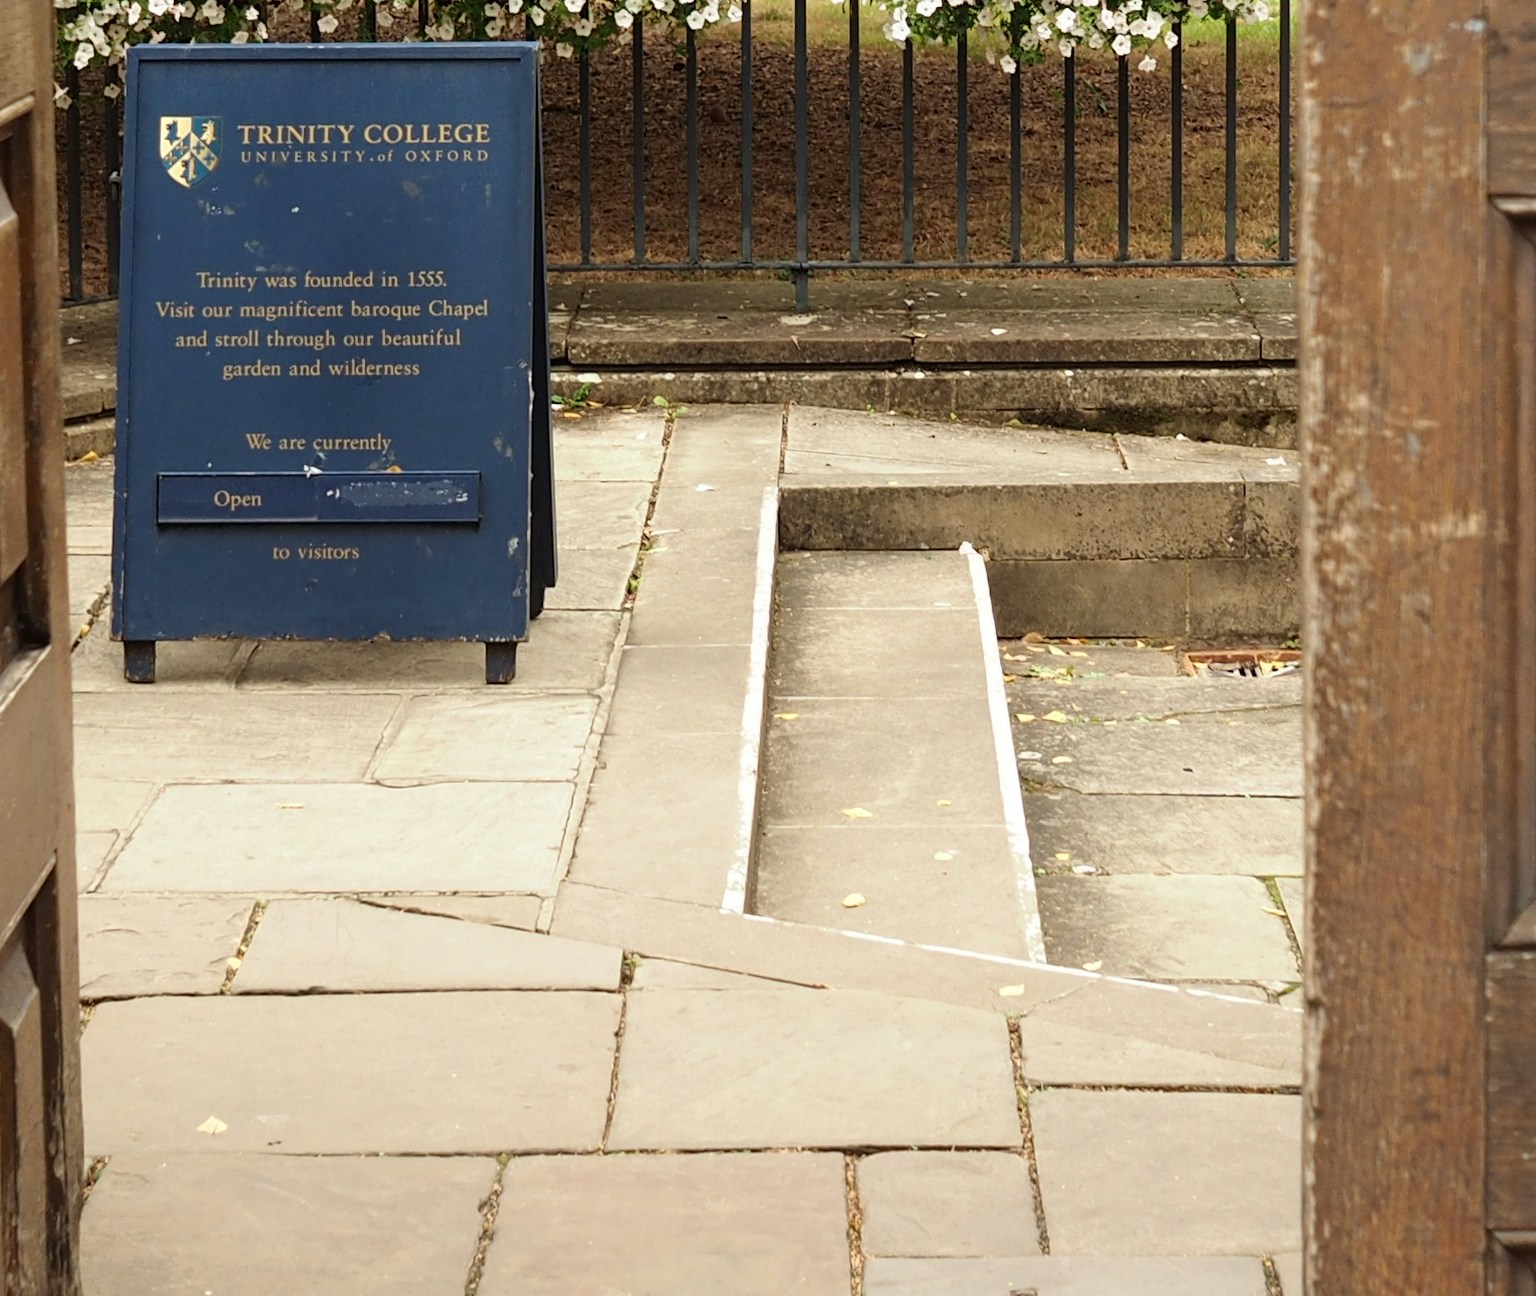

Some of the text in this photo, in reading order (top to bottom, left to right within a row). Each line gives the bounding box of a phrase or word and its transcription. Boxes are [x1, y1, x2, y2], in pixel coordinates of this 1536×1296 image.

[238, 123, 490, 145] TRINITY COLLEGE
[241, 151, 366, 163] UNIVERSITY
[405, 150, 489, 162] OXFORD
[196, 271, 447, 292] Trinity was founded in 1555.
[155, 300, 489, 321] Visit our magnificent baroque Chapel
[175, 329, 462, 350] and stroll through our beautiful
[222, 360, 421, 381] garden and wilderness
[245, 433, 392, 454] We are currently
[213, 490, 263, 511] Open
[273, 544, 361, 561] to visitors
